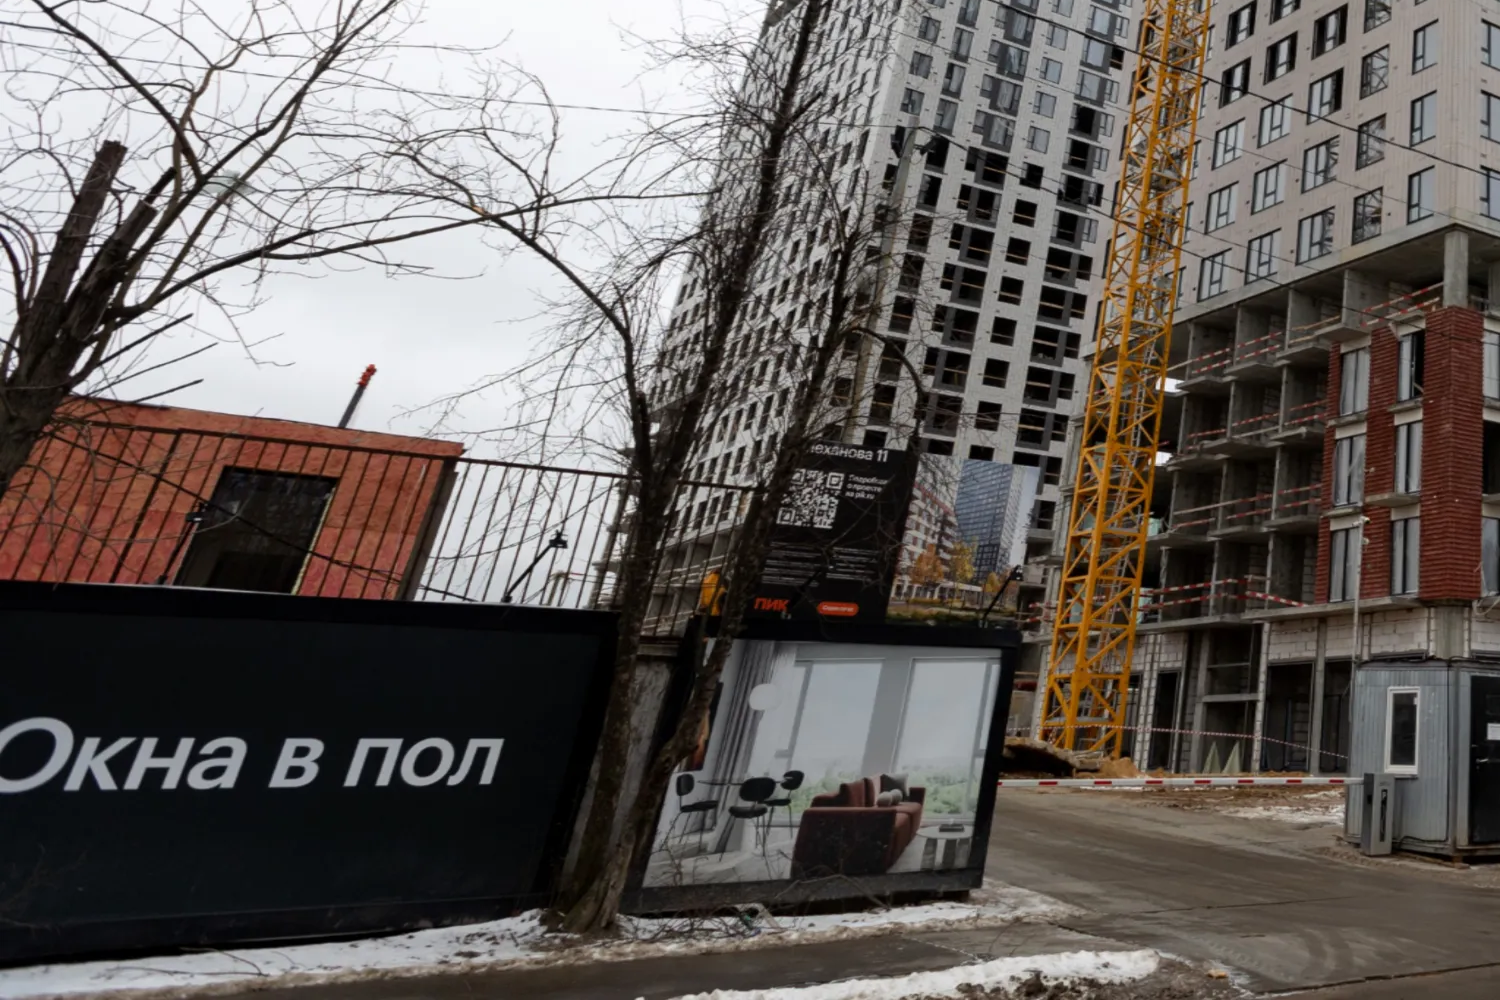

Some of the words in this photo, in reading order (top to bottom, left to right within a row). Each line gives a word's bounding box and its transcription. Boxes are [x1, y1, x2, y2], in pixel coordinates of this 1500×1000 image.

[810, 442, 873, 461] еханова
[876, 449, 889, 463] 11
[754, 597, 789, 613] ПИК
[0, 716, 248, 794] Окна
[268, 737, 325, 789] в
[343, 737, 505, 787] пол
